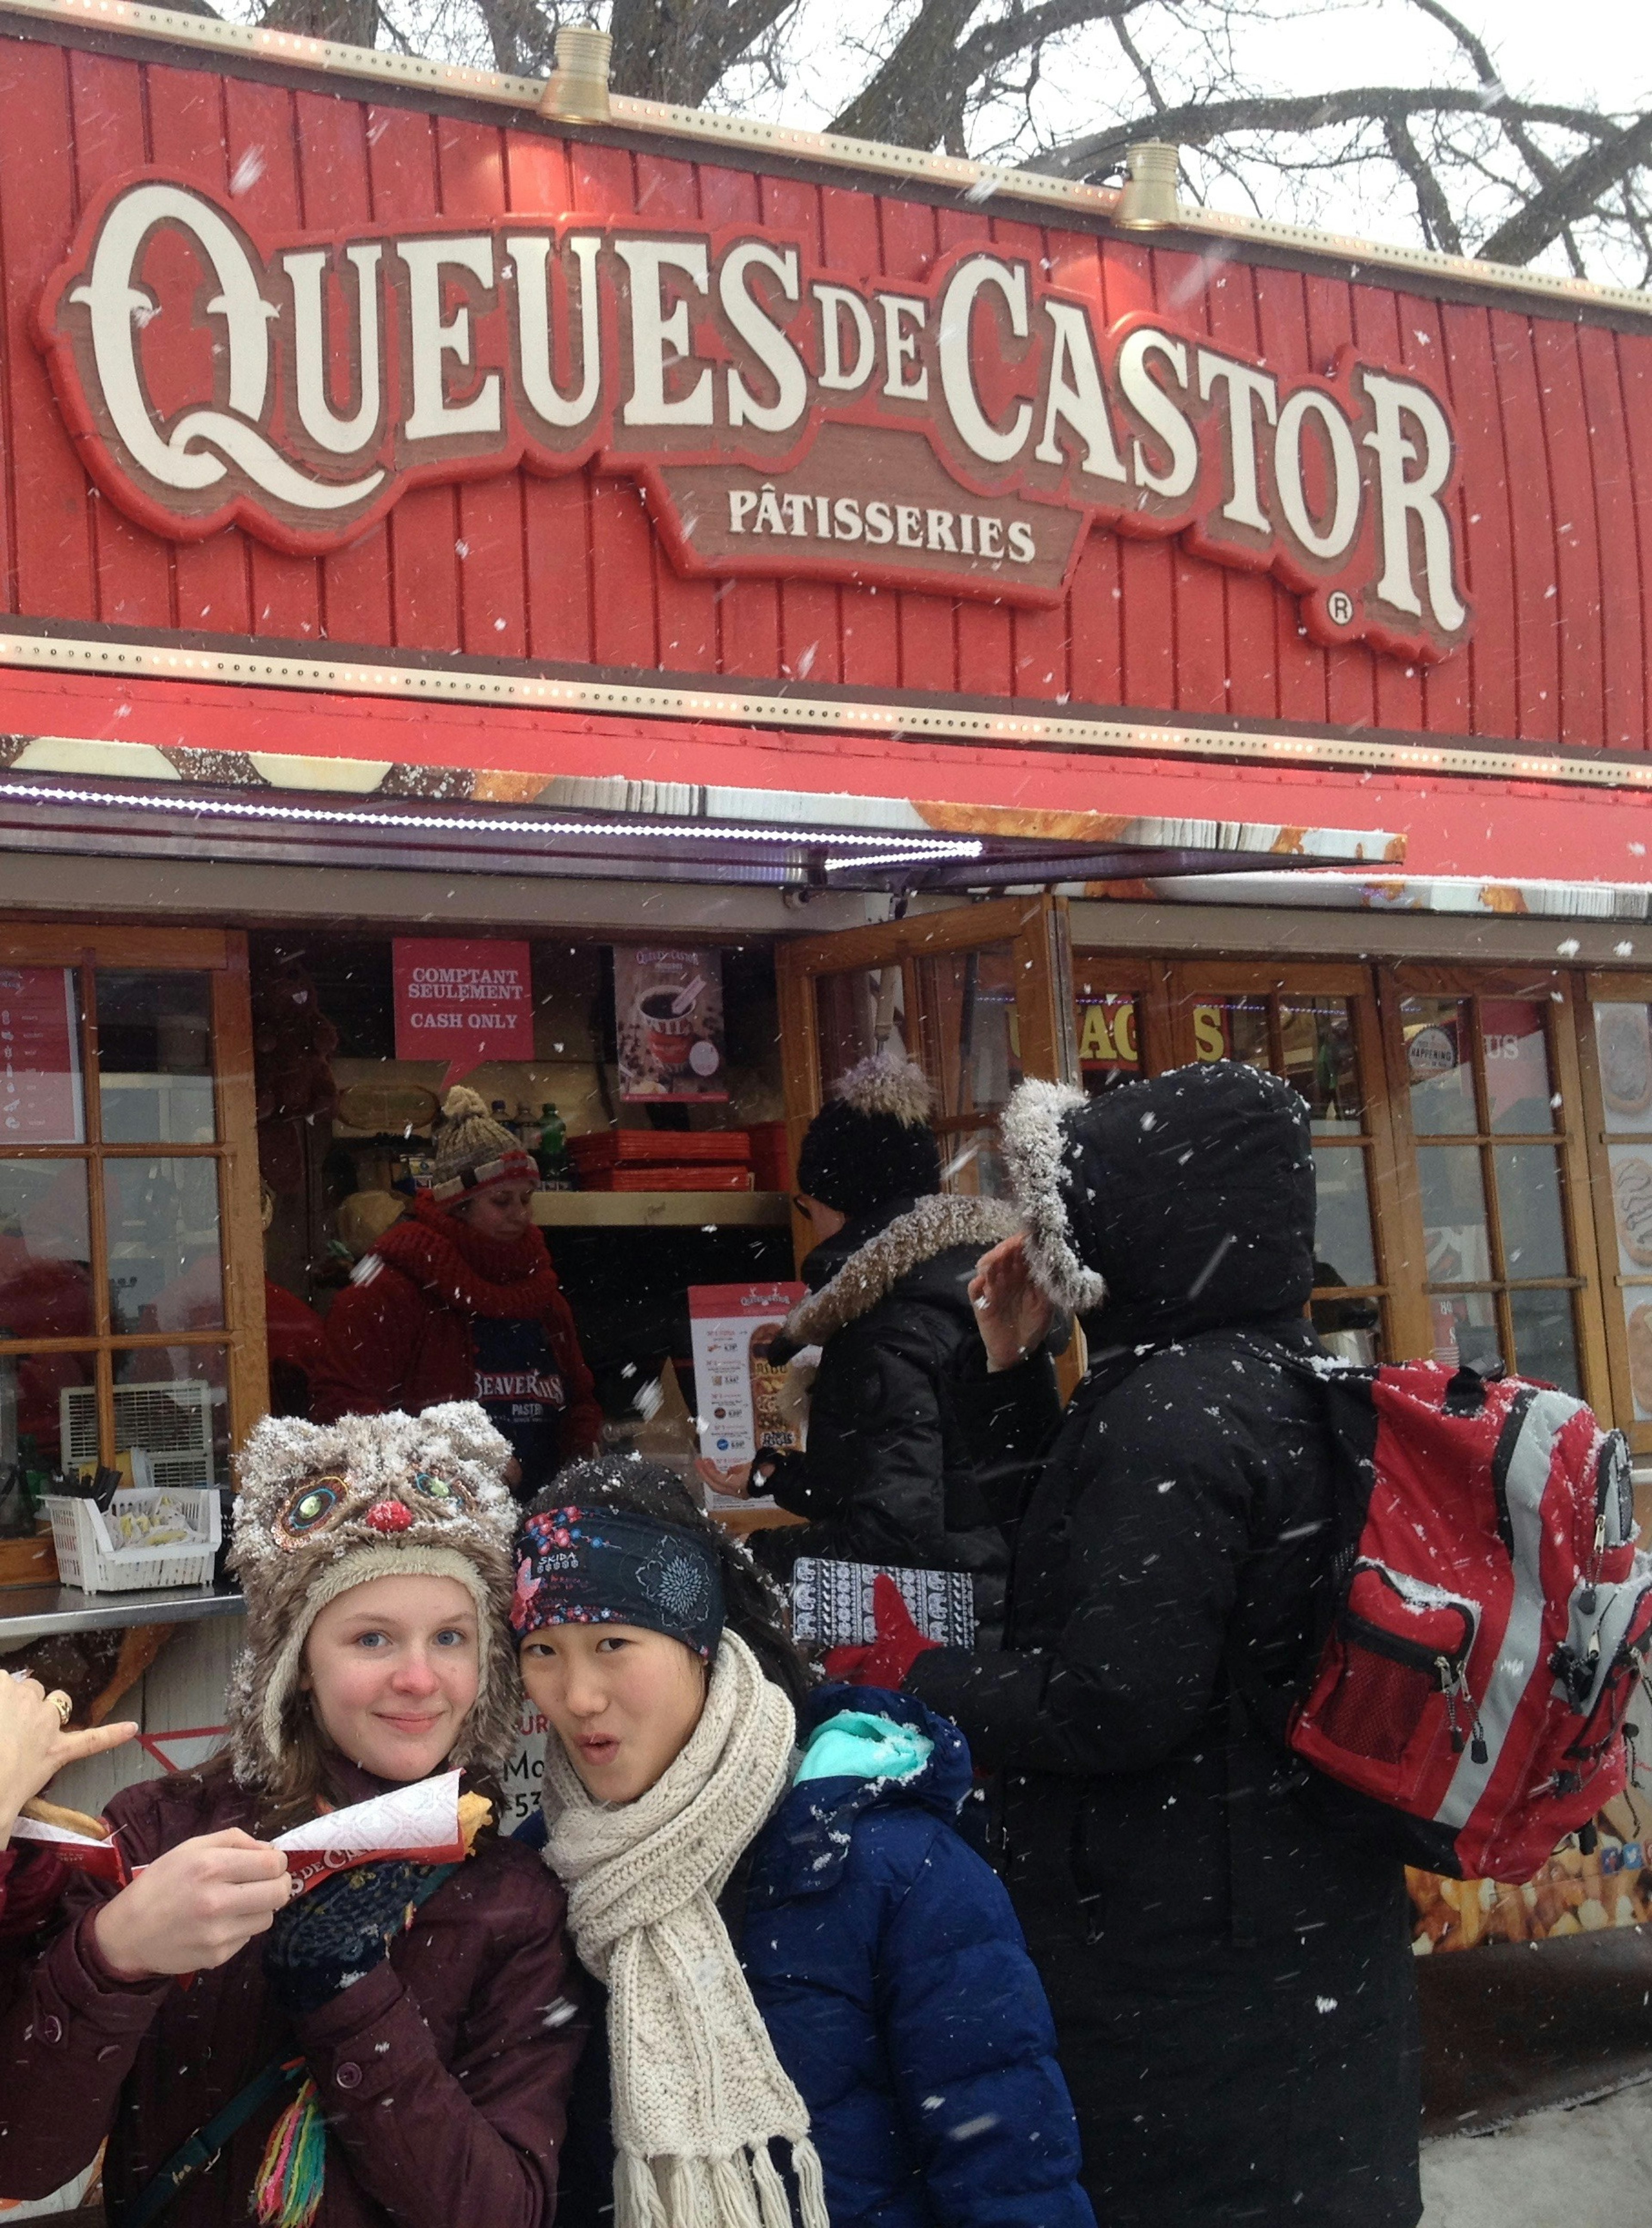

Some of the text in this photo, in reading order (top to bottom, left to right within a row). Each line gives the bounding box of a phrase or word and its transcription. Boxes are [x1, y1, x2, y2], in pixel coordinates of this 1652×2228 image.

[70, 184, 807, 508] QUEUES
[813, 284, 928, 401] DE
[940, 259, 1465, 631] CASTOR
[728, 483, 1035, 563] PÂTISSERIES
[413, 968, 518, 984] COMPTANT
[408, 983, 523, 999] SEULEMENT
[410, 1013, 518, 1029] CASH ONLY
[539, 1552, 576, 1565] SKIDA
[300, 1861, 325, 1880] DE
